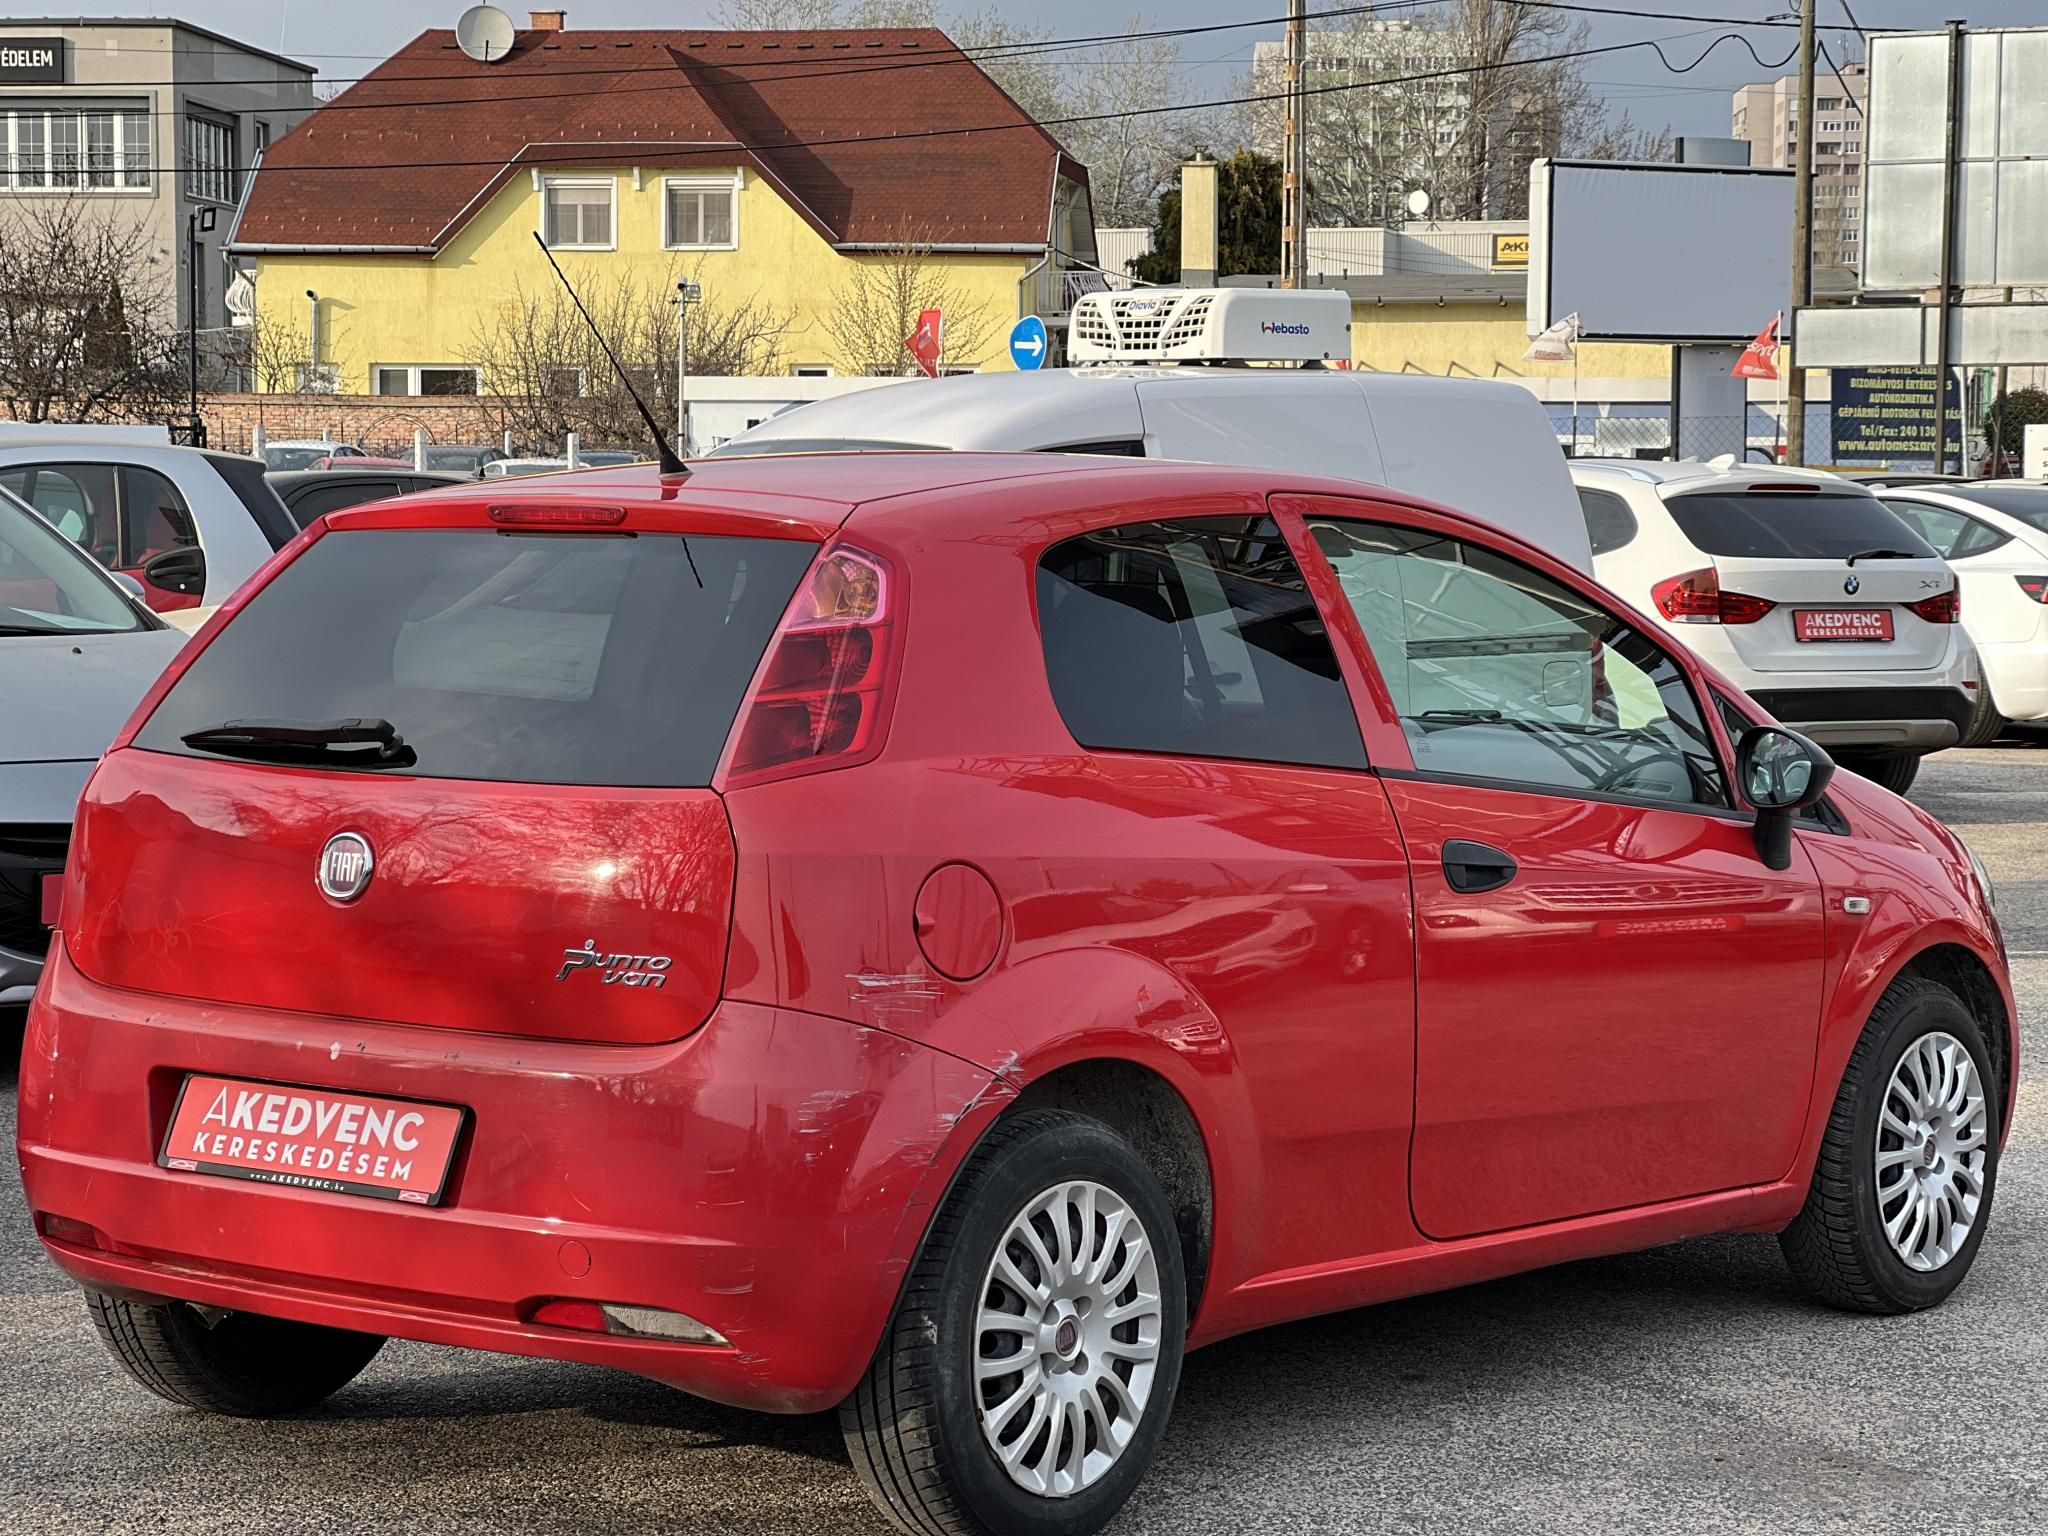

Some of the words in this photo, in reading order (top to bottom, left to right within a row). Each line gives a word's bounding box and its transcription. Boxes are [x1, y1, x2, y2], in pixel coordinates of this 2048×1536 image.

[0, 46, 53, 67] ÉDELEM
[1261, 321, 1310, 335] Webasto
[1850, 377, 1904, 389] BIZOMÁNYOSI
[1906, 378, 1953, 390] ÉRTÉKESS
[1869, 391, 1935, 403] AUTÓKOZMETIKA
[1881, 408, 1920, 418] MOTOROK
[1861, 425, 1898, 436] Tel/Fax:
[1900, 426, 1917, 436] 240
[1806, 614, 1881, 626] AKEDVENC
[1806, 624, 1883, 636] KERESKEDÉSEM
[329, 851, 362, 882] FIAT
[601, 970, 666, 988] van
[201, 1085, 425, 1152] AKEDVENC
[192, 1131, 413, 1181] KERESKEDÉSEM
